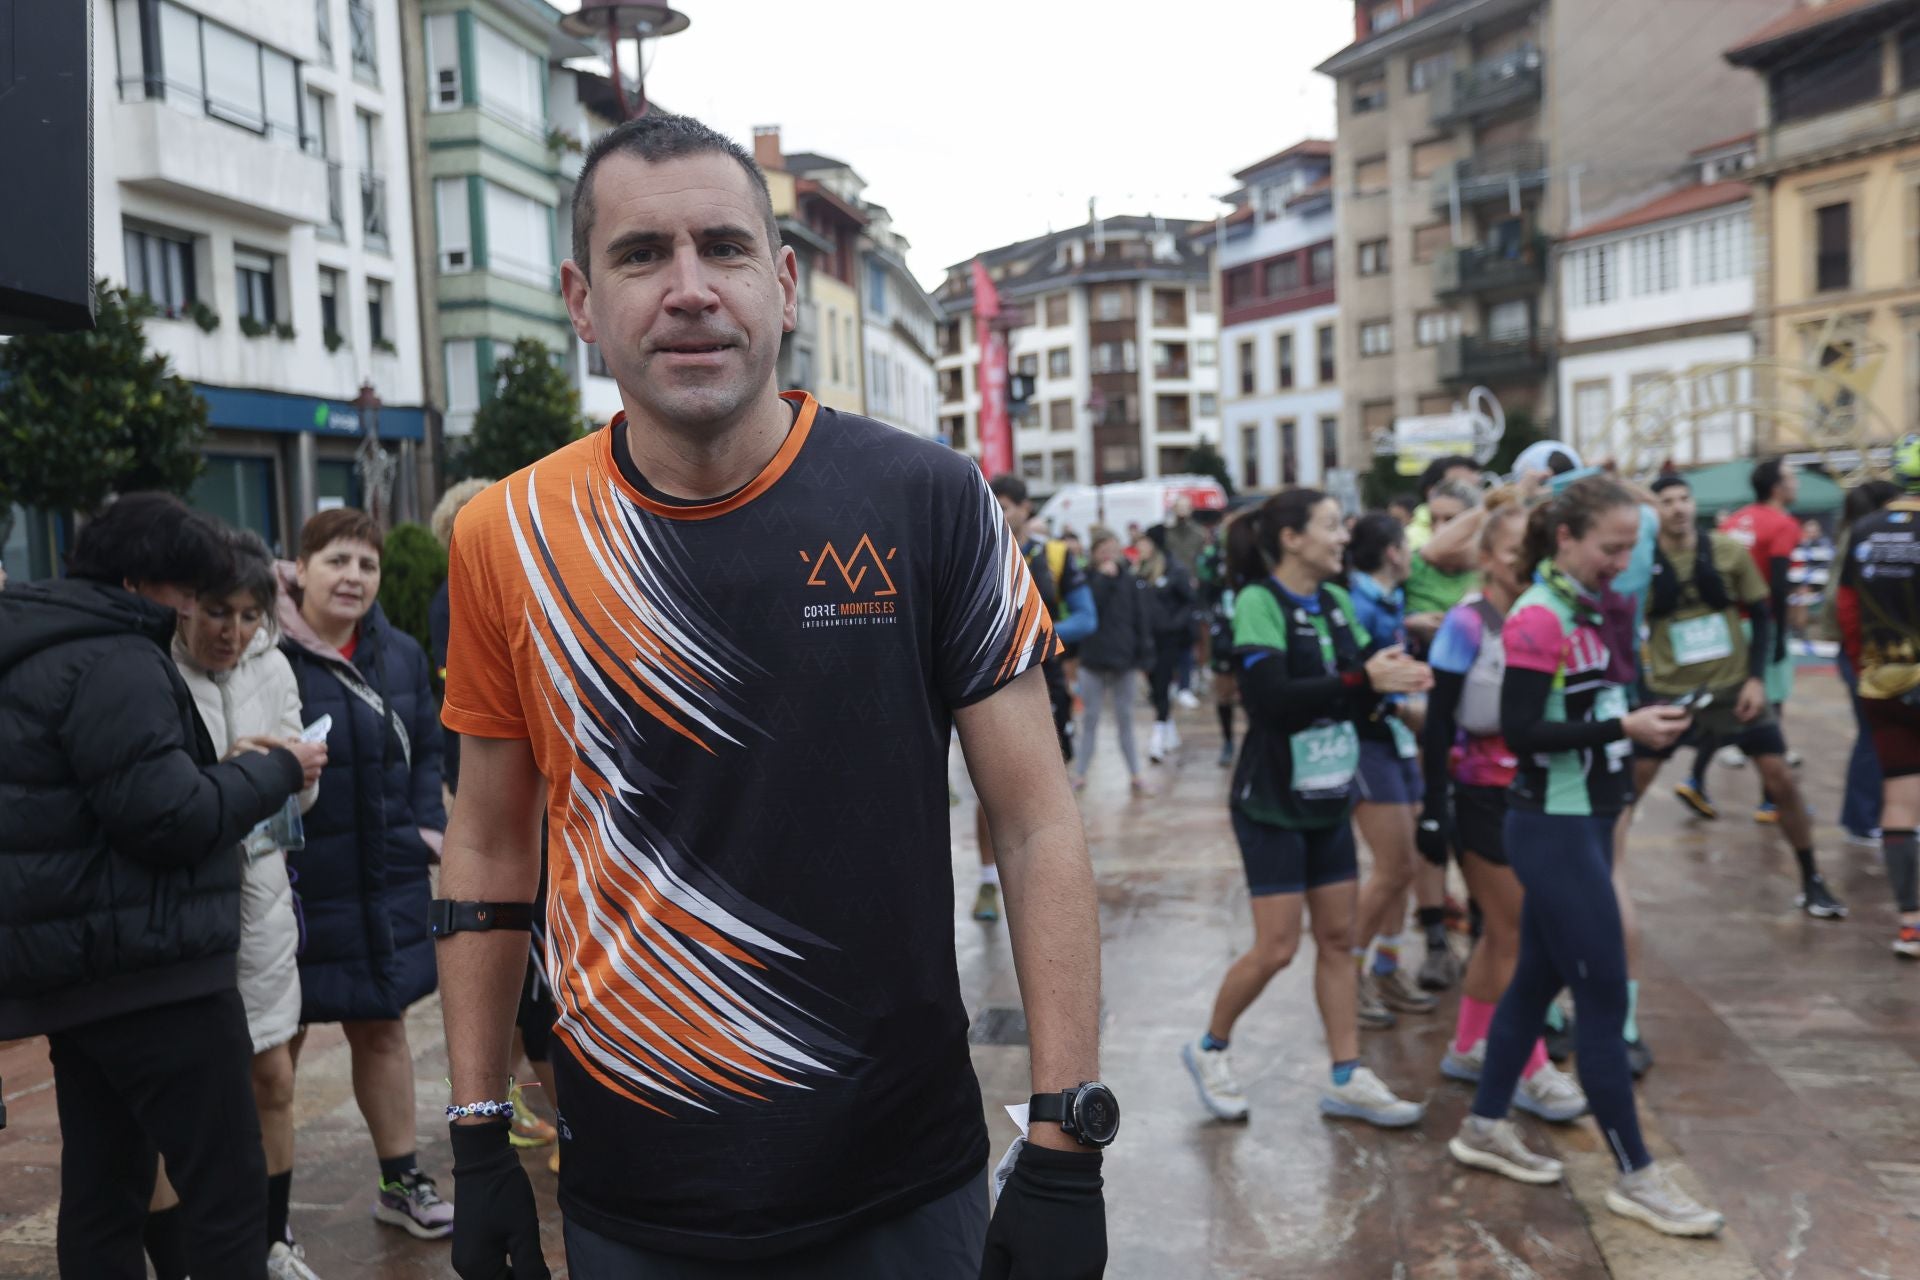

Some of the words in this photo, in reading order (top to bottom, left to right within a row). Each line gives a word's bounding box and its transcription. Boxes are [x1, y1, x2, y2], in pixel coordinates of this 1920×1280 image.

[804, 604, 836, 618] CORRE
[840, 601, 895, 615] MONTES.ES
[802, 617, 867, 628] ENTRENAMIENTOS
[872, 616, 897, 625] ONLINE
